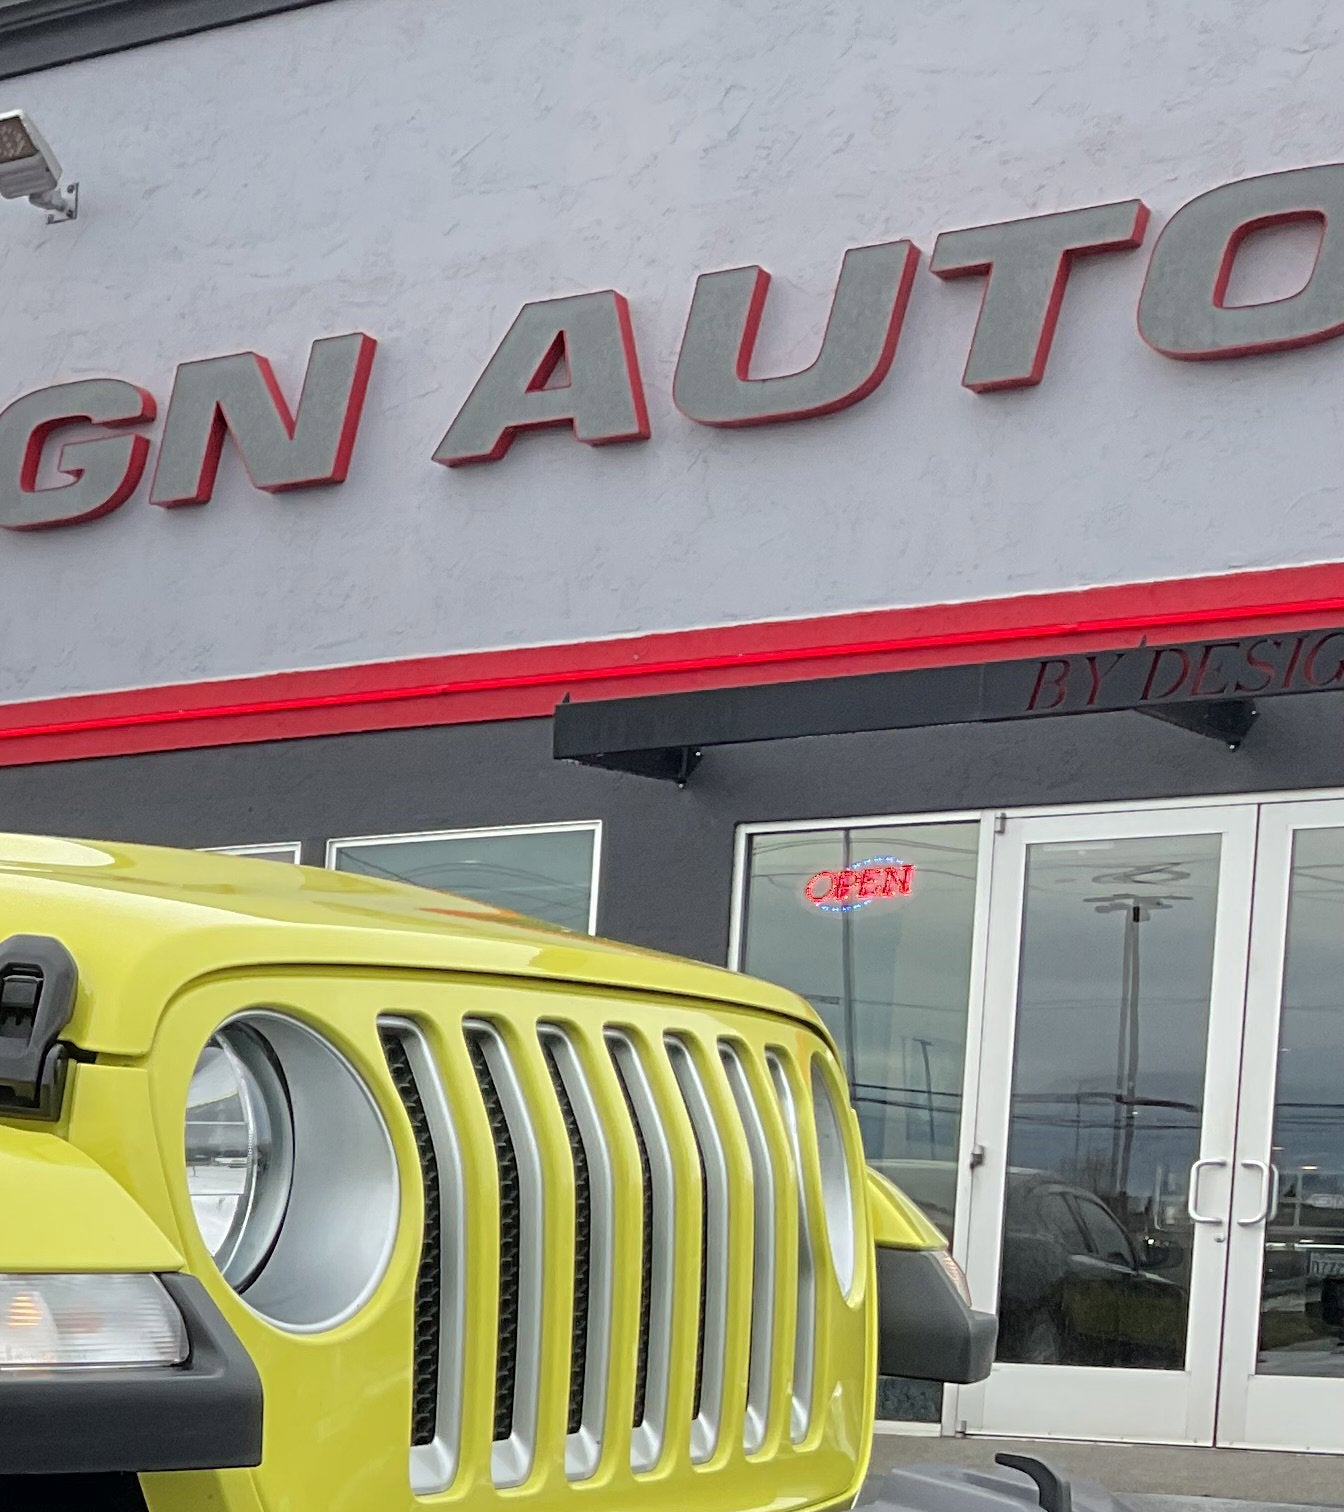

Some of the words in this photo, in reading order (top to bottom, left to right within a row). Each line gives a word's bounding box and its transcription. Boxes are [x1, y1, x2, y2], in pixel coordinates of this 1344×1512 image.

[431, 163, 1344, 467] AUTO
[1026, 653, 1125, 711] BY
[1139, 631, 1344, 701] DESIG
[805, 864, 915, 903] OPEN
